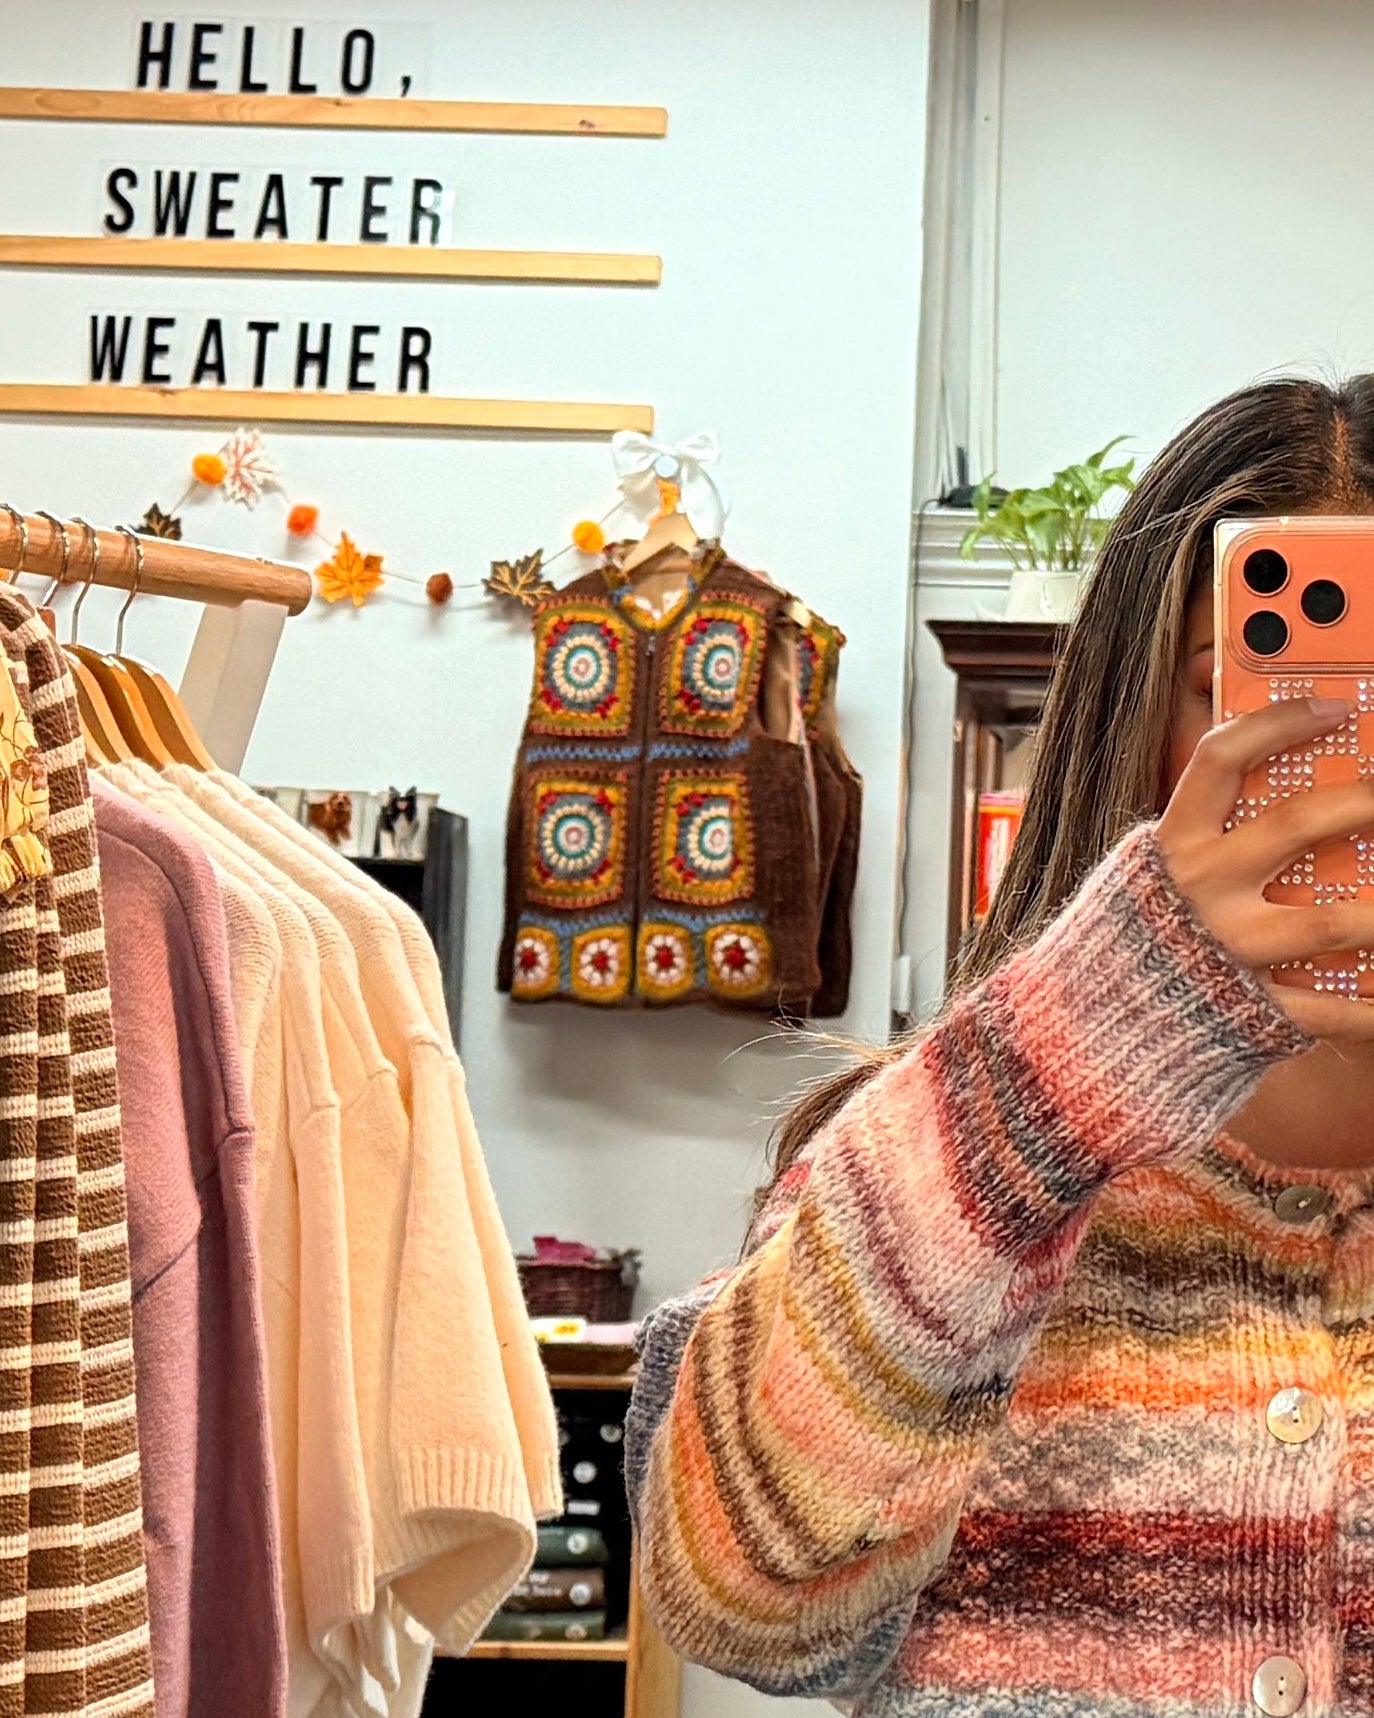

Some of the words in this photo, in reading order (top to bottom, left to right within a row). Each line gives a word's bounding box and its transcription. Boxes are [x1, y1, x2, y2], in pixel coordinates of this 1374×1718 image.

[136, 21, 411, 96] HELLO,
[104, 168, 443, 245] SWEATER
[90, 315, 432, 392] WEATHER
